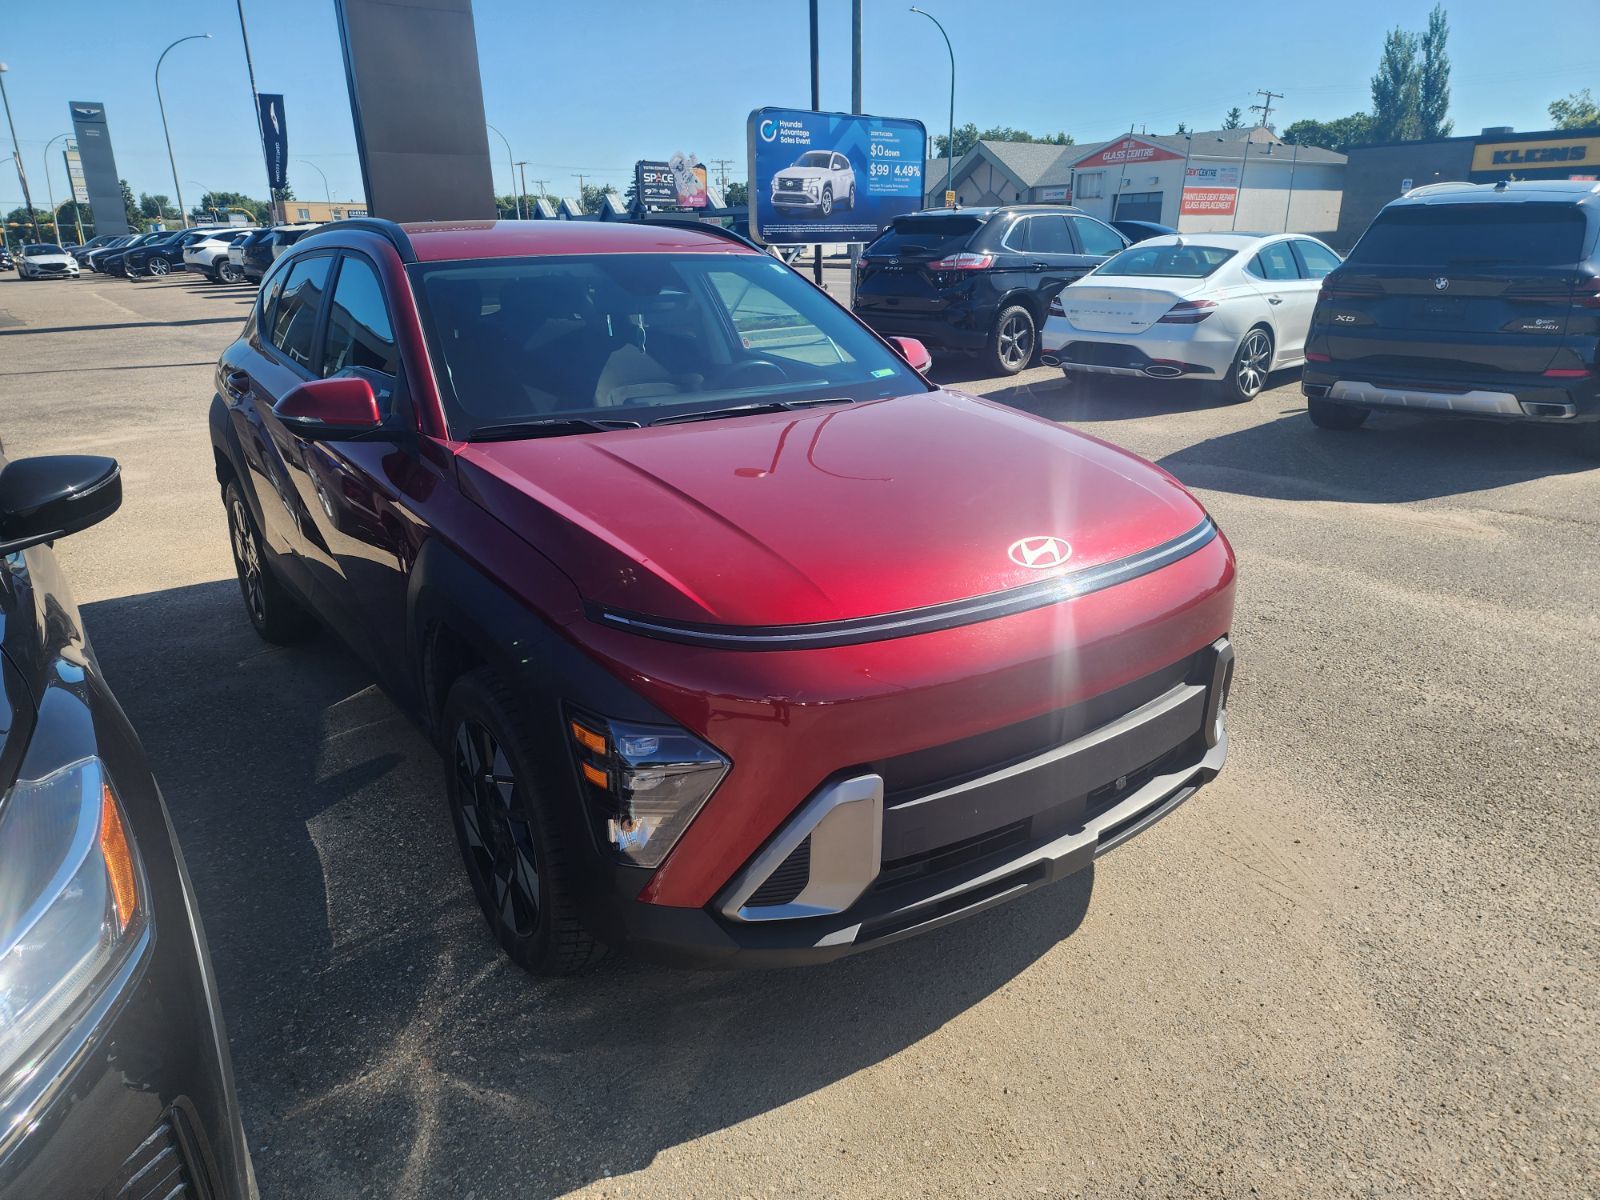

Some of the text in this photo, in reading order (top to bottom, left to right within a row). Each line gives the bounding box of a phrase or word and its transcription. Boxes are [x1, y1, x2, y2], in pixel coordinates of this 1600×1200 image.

[779, 120, 803, 128] Hyundai
[780, 128, 810, 138] Advantage
[796, 137, 811, 145] Event
[884, 148, 901, 157] down
[1102, 150, 1126, 160] GLASS
[1126, 148, 1154, 158] CENTRE
[870, 163, 921, 177] $99 4.49%
[644, 172, 674, 183] SPACE
